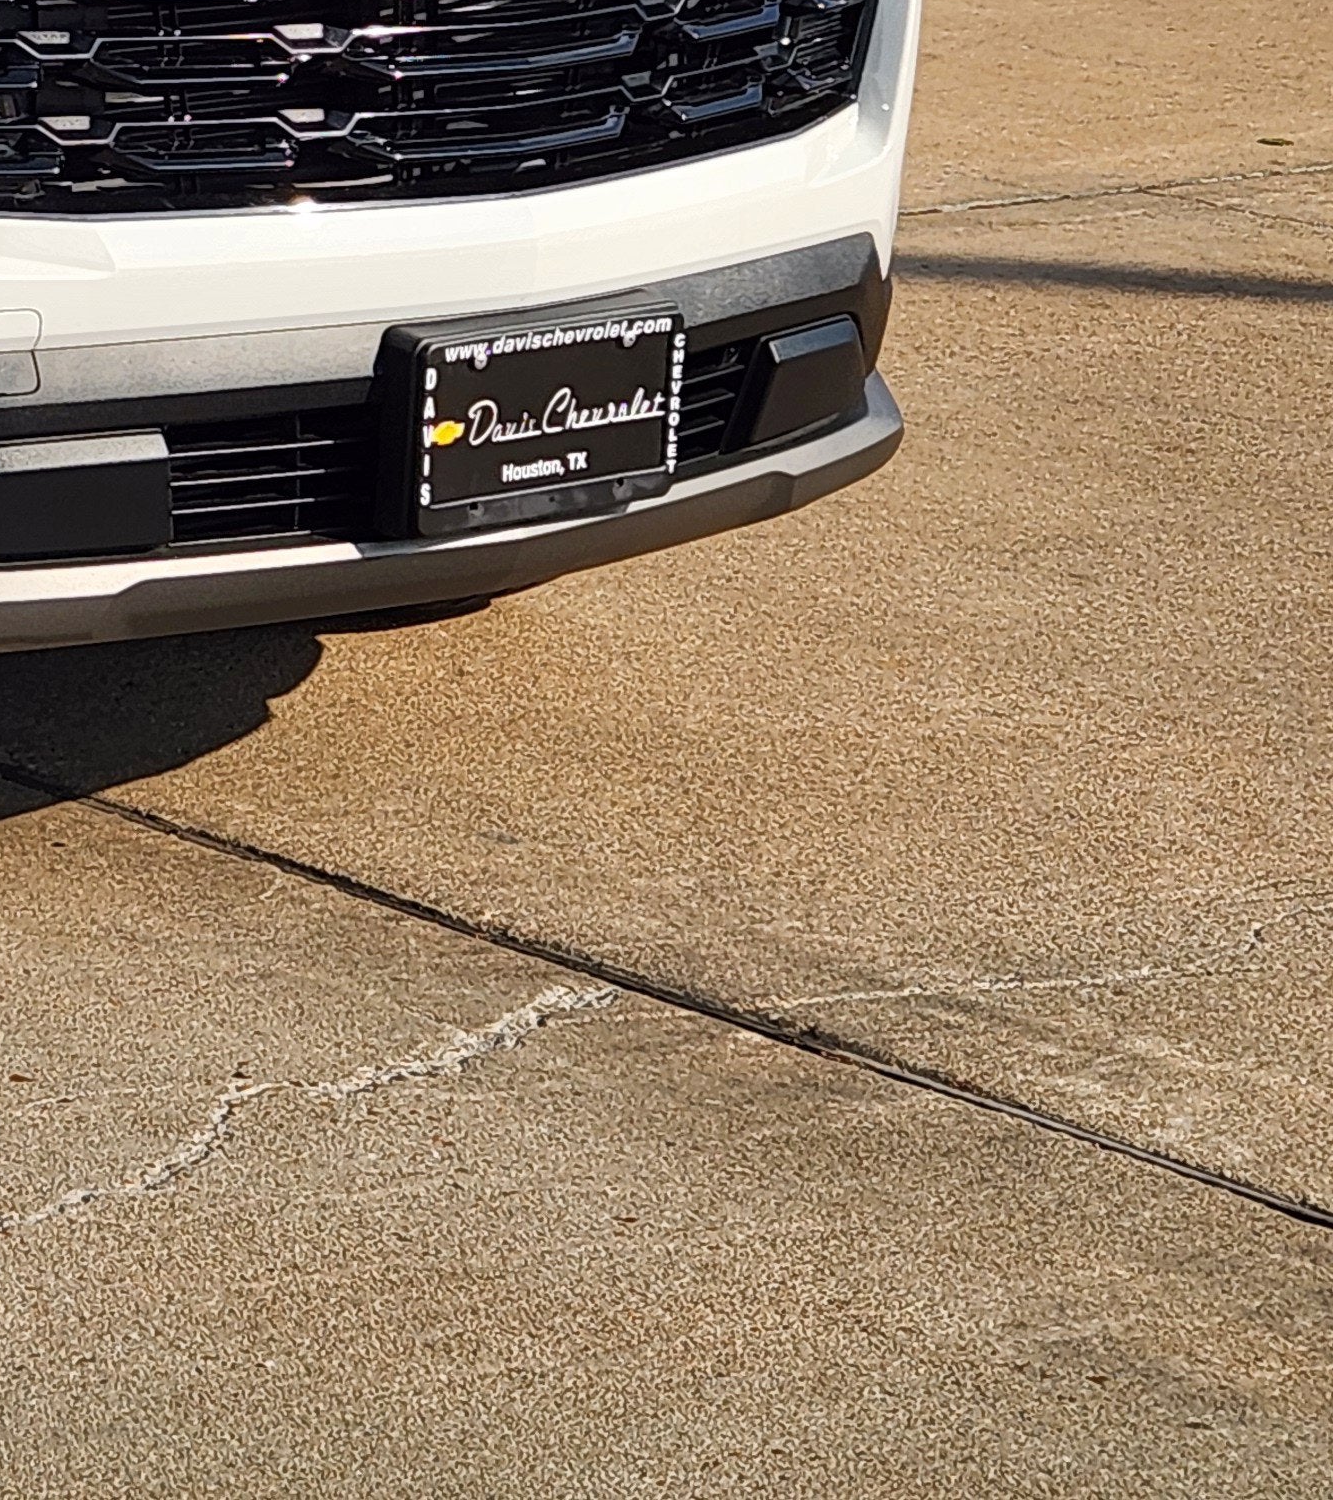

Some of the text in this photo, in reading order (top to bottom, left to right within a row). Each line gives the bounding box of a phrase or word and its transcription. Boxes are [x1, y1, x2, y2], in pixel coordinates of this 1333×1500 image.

[444, 318, 673, 363] www.davischevrolet.com
[467, 386, 666, 446] Davis Chevrolet
[665, 332, 687, 474] CHEVROLET
[419, 367, 438, 506] DAVIS
[501, 450, 589, 483] Houston, TX
